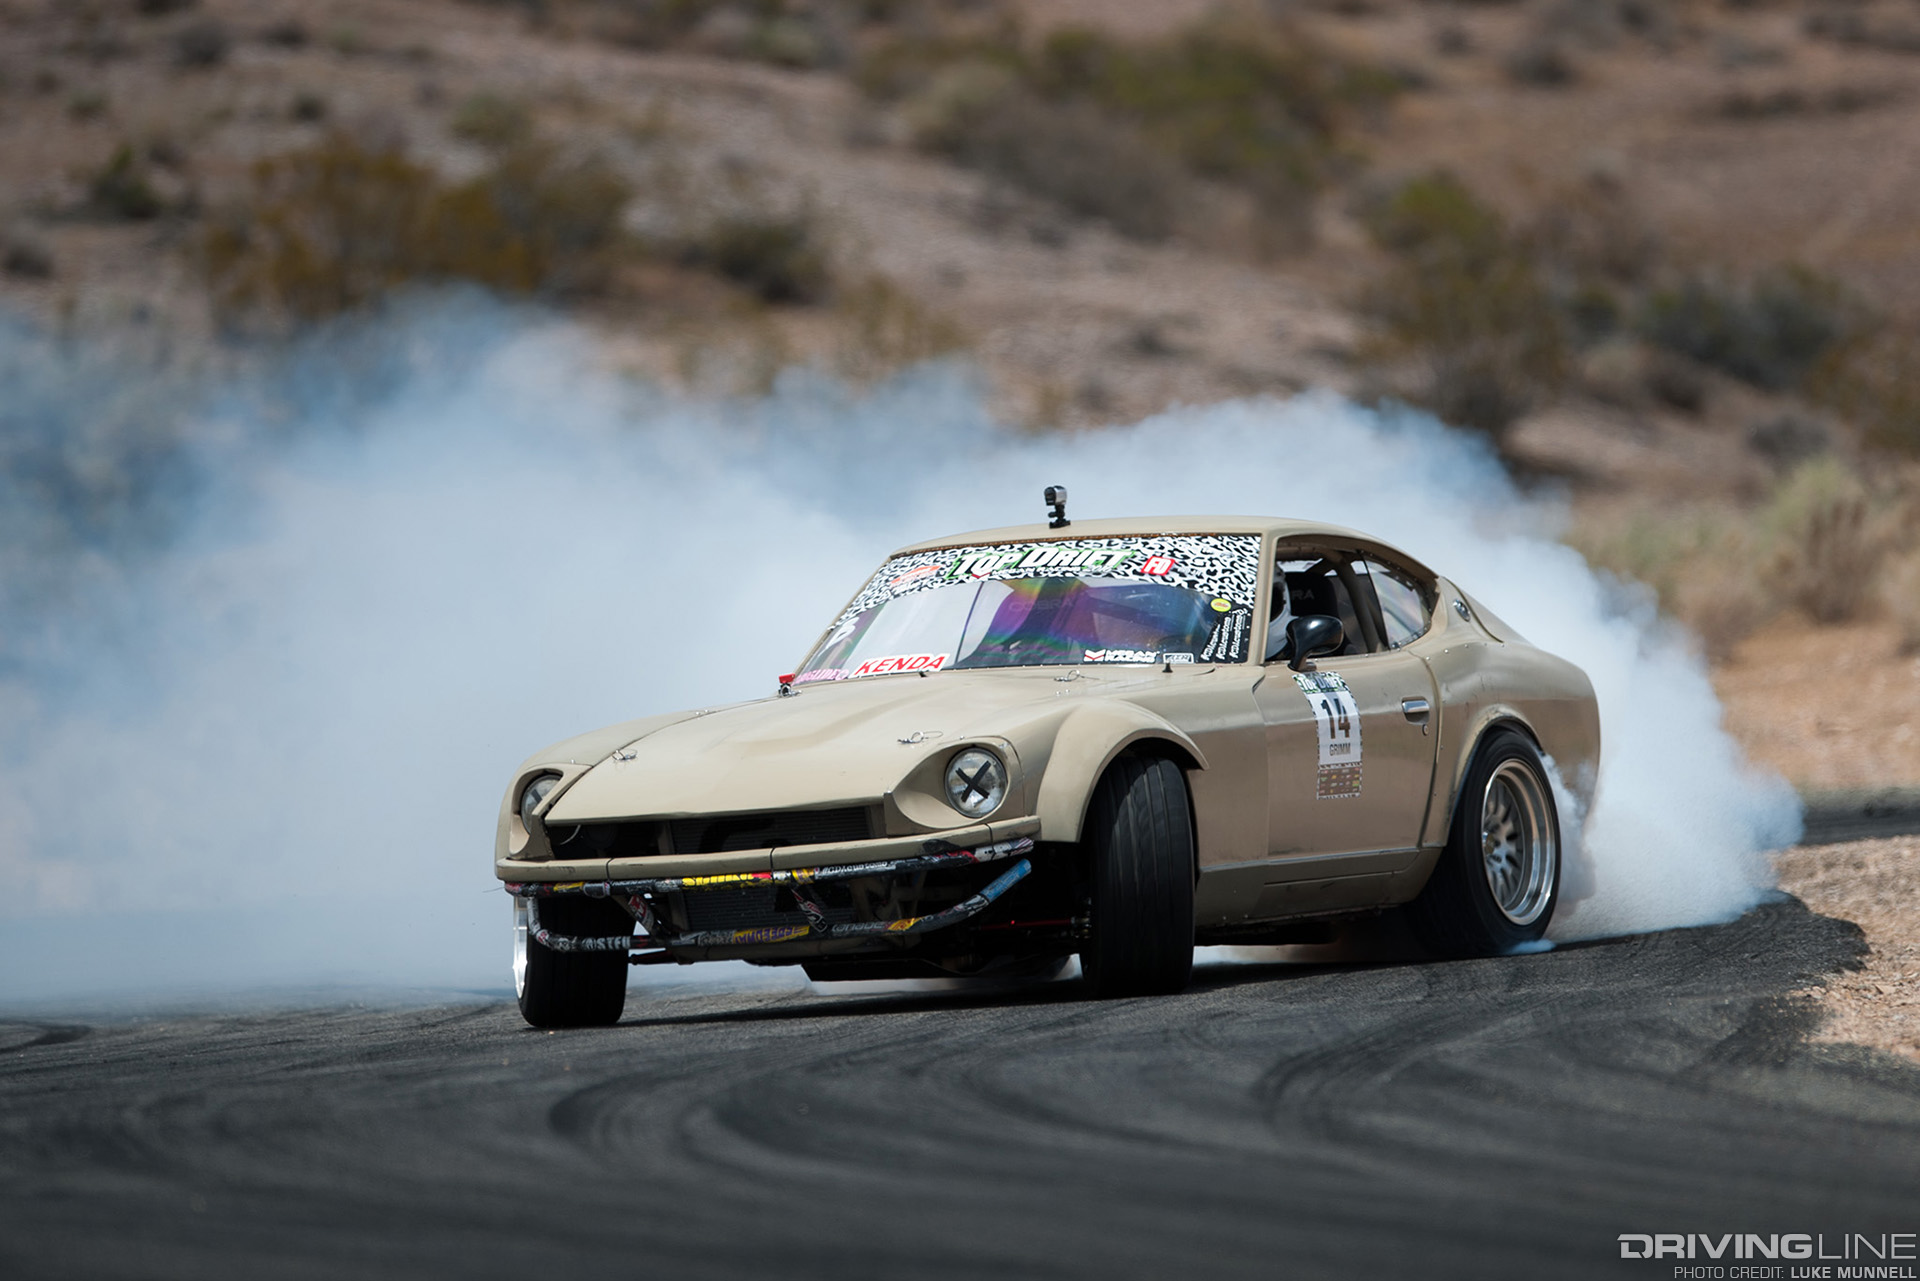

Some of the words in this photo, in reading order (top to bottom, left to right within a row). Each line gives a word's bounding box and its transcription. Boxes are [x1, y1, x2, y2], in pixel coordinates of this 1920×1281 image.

[951, 553, 1022, 576] TOP
[1014, 547, 1130, 568] DRIFT
[1143, 557, 1172, 574] FD
[854, 656, 946, 675] KENDA
[1321, 699, 1351, 739] 14
[1329, 743, 1351, 756] GRIMM
